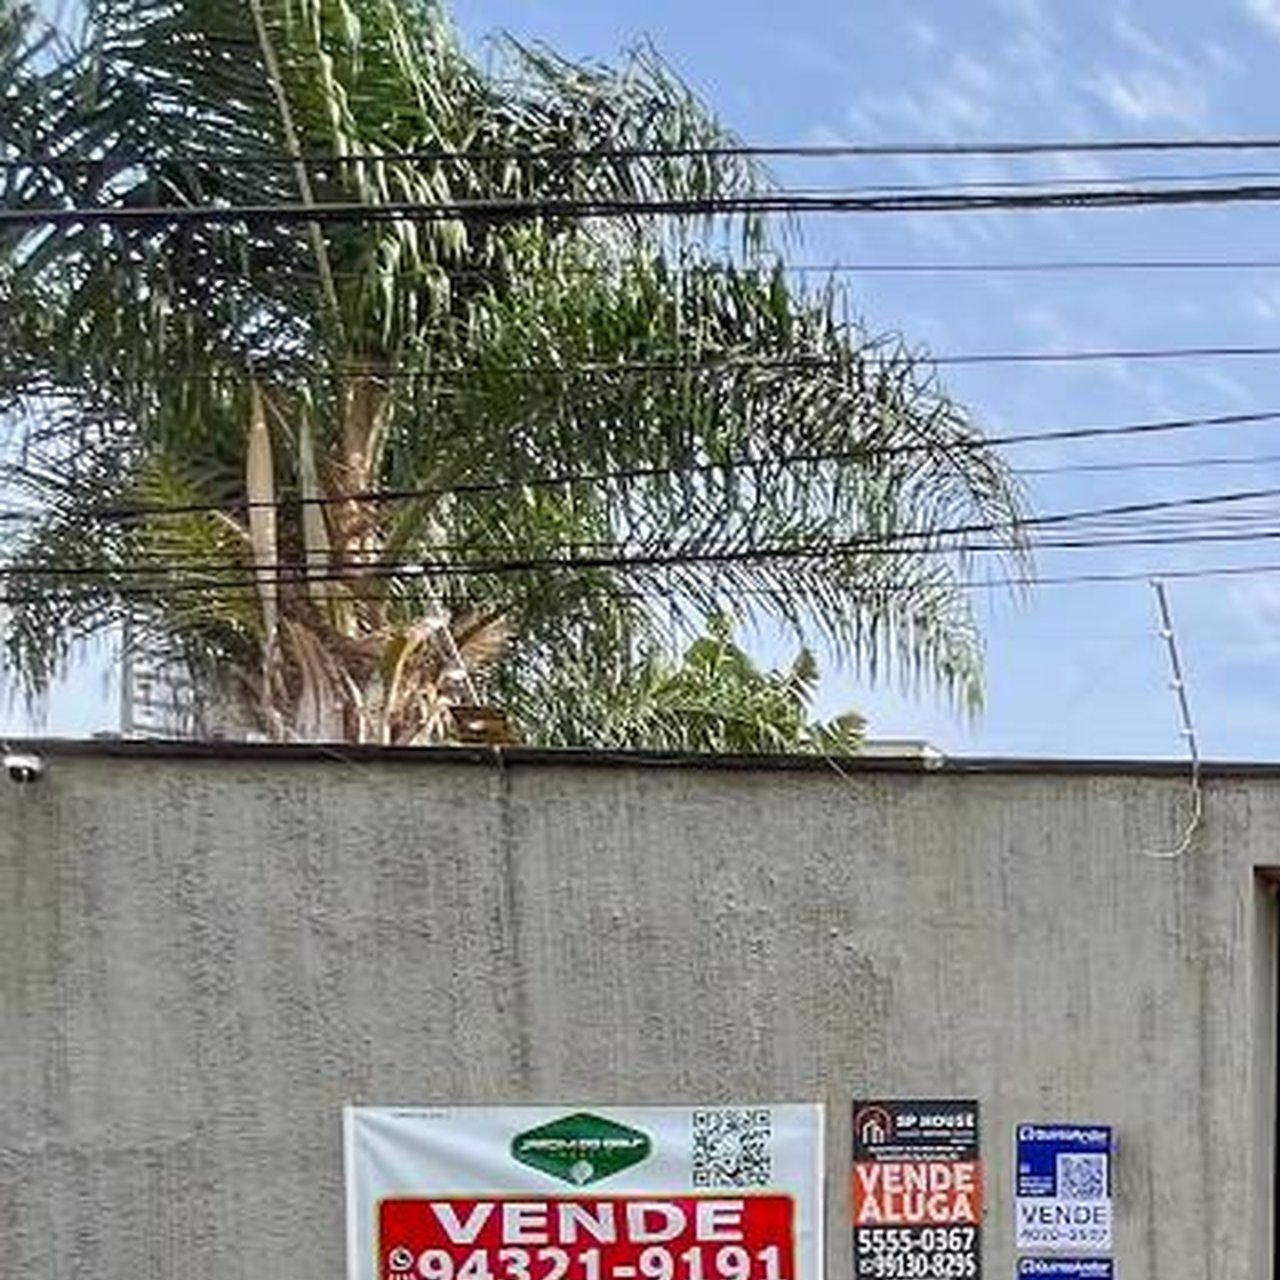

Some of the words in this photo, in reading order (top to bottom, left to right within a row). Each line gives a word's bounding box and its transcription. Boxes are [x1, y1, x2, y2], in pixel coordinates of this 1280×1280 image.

[857, 1163, 976, 1193] VENDE
[430, 1200, 745, 1245] VENDE
[857, 1193, 975, 1223] ALUGA
[1022, 1205, 1107, 1225] VENDE
[858, 1227, 975, 1254] 5555-0367
